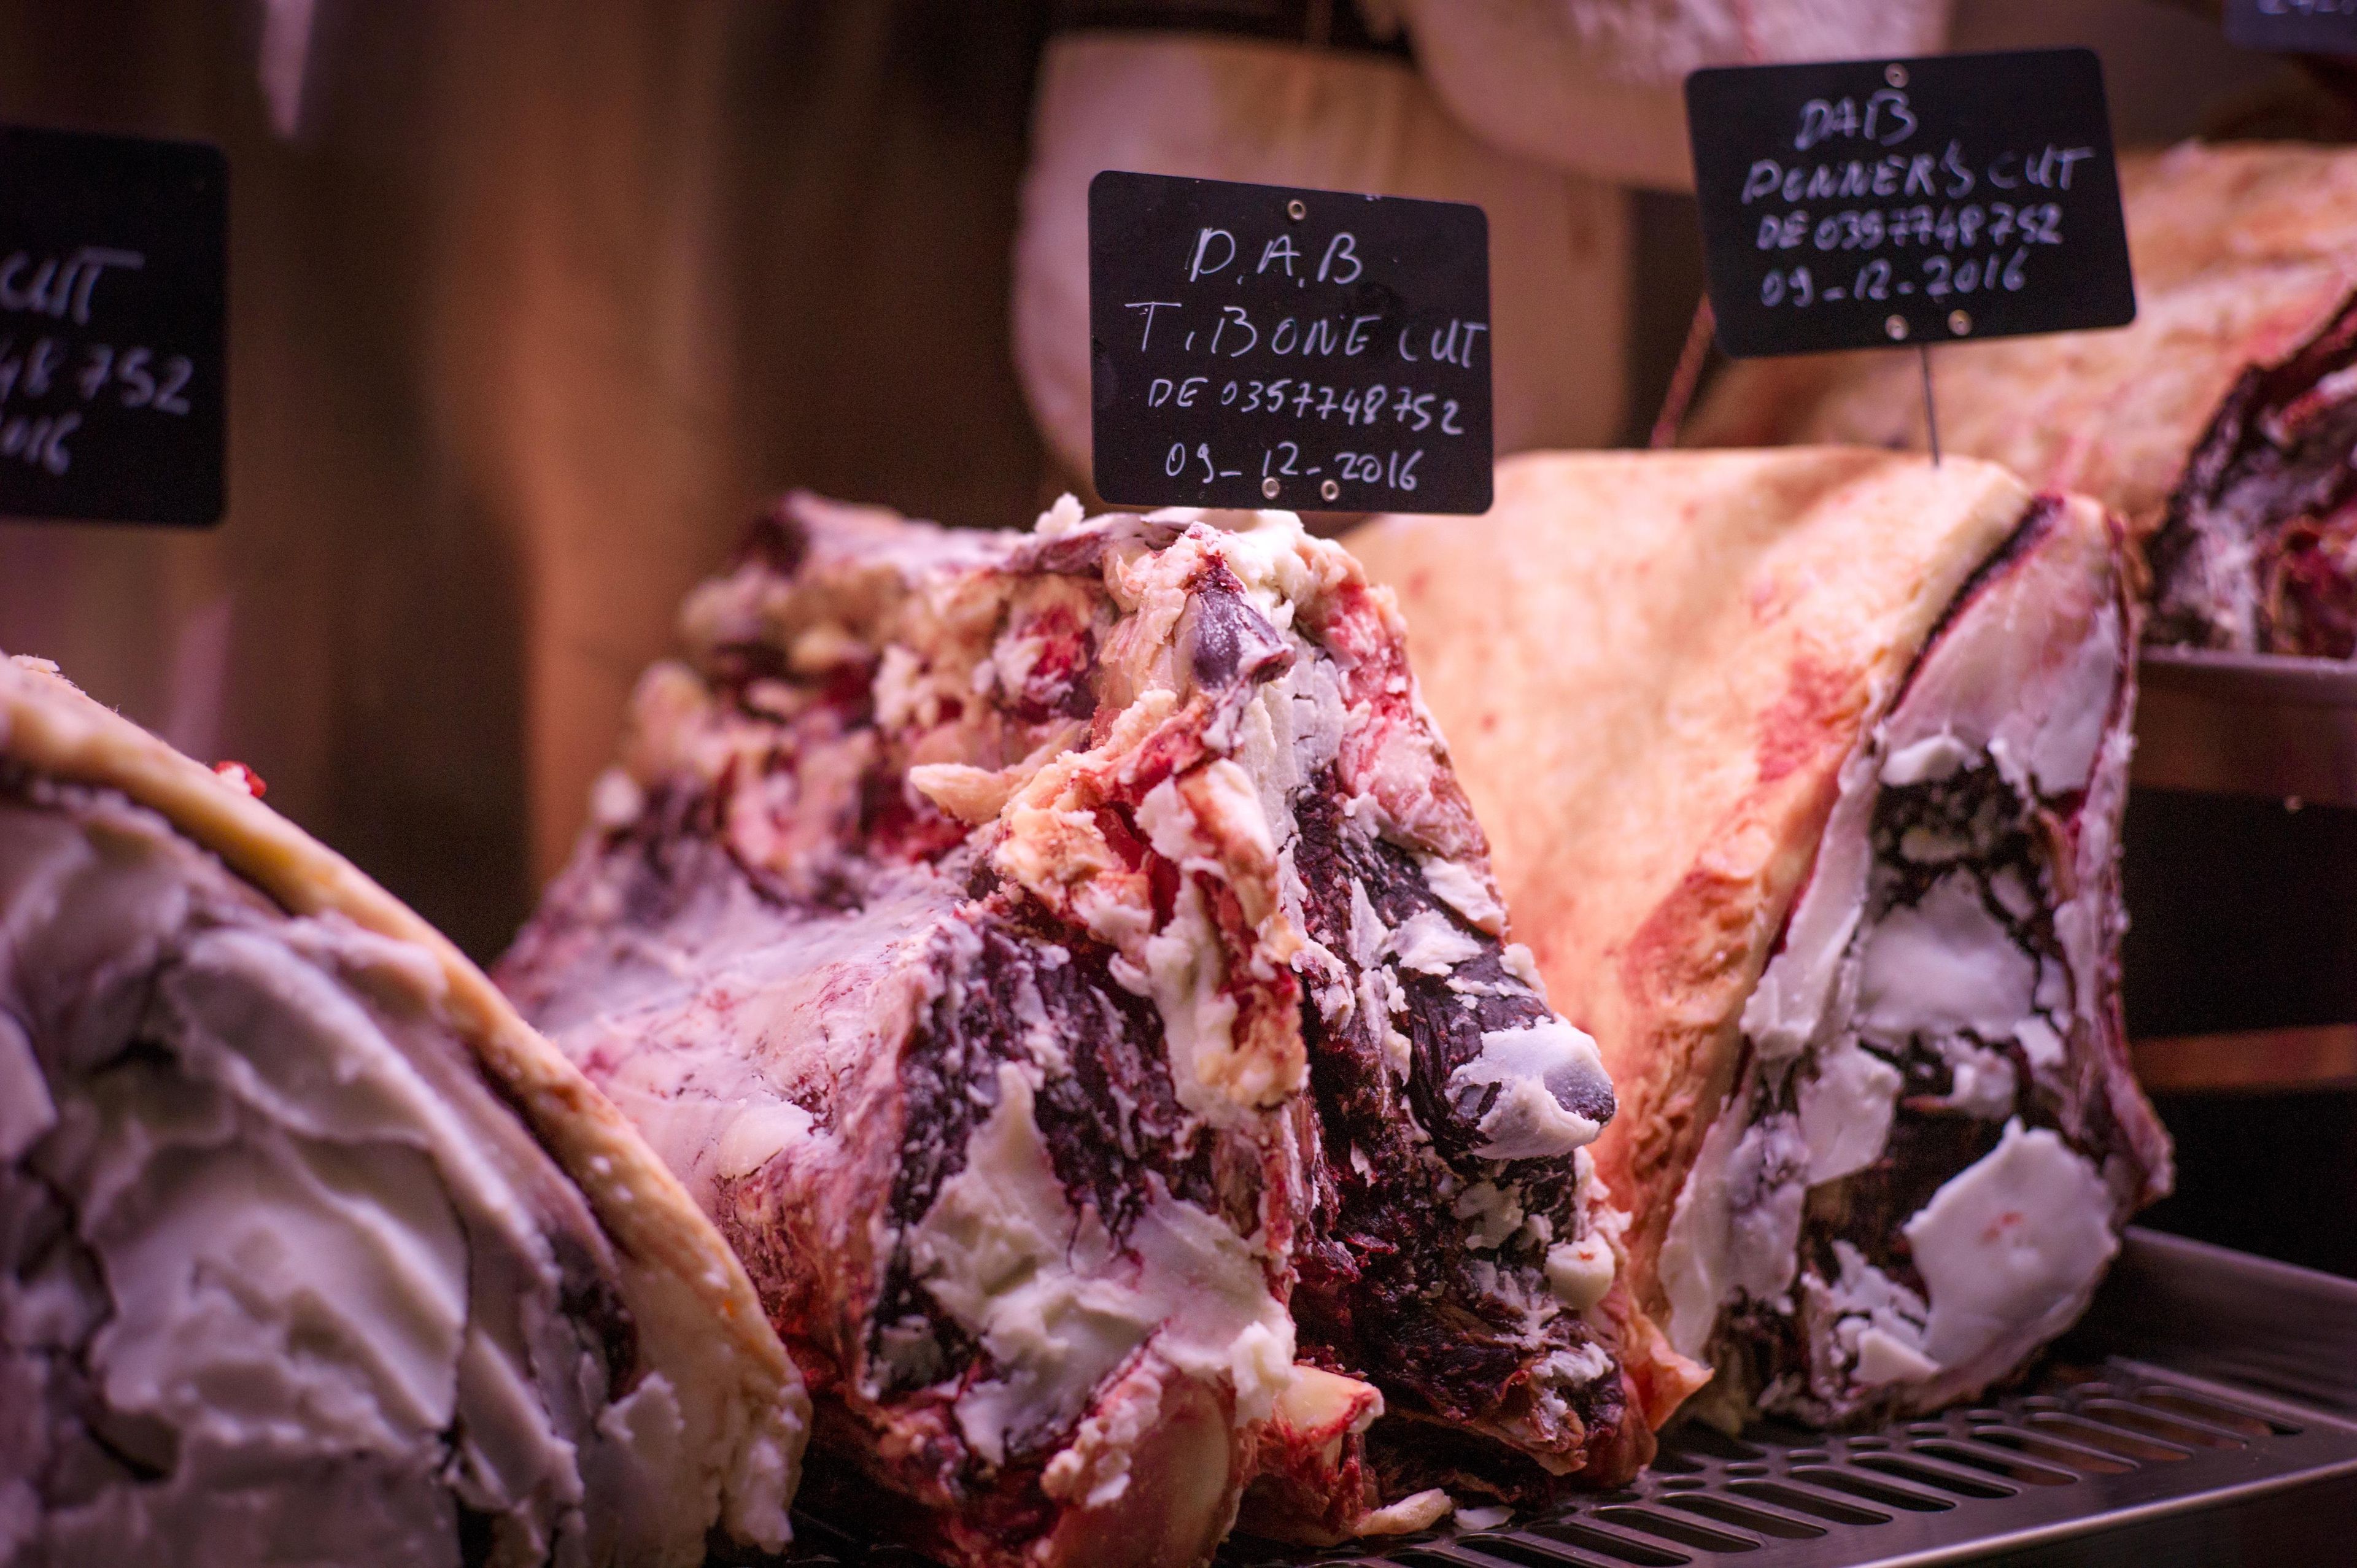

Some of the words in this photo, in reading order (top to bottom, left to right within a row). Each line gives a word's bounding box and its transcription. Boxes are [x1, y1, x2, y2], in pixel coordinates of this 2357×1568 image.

[1987, 144, 2094, 190] CUT
[1185, 227, 1363, 288] D.A.B
[1398, 318, 1488, 369] CUT
[1147, 376, 1209, 409] DE
